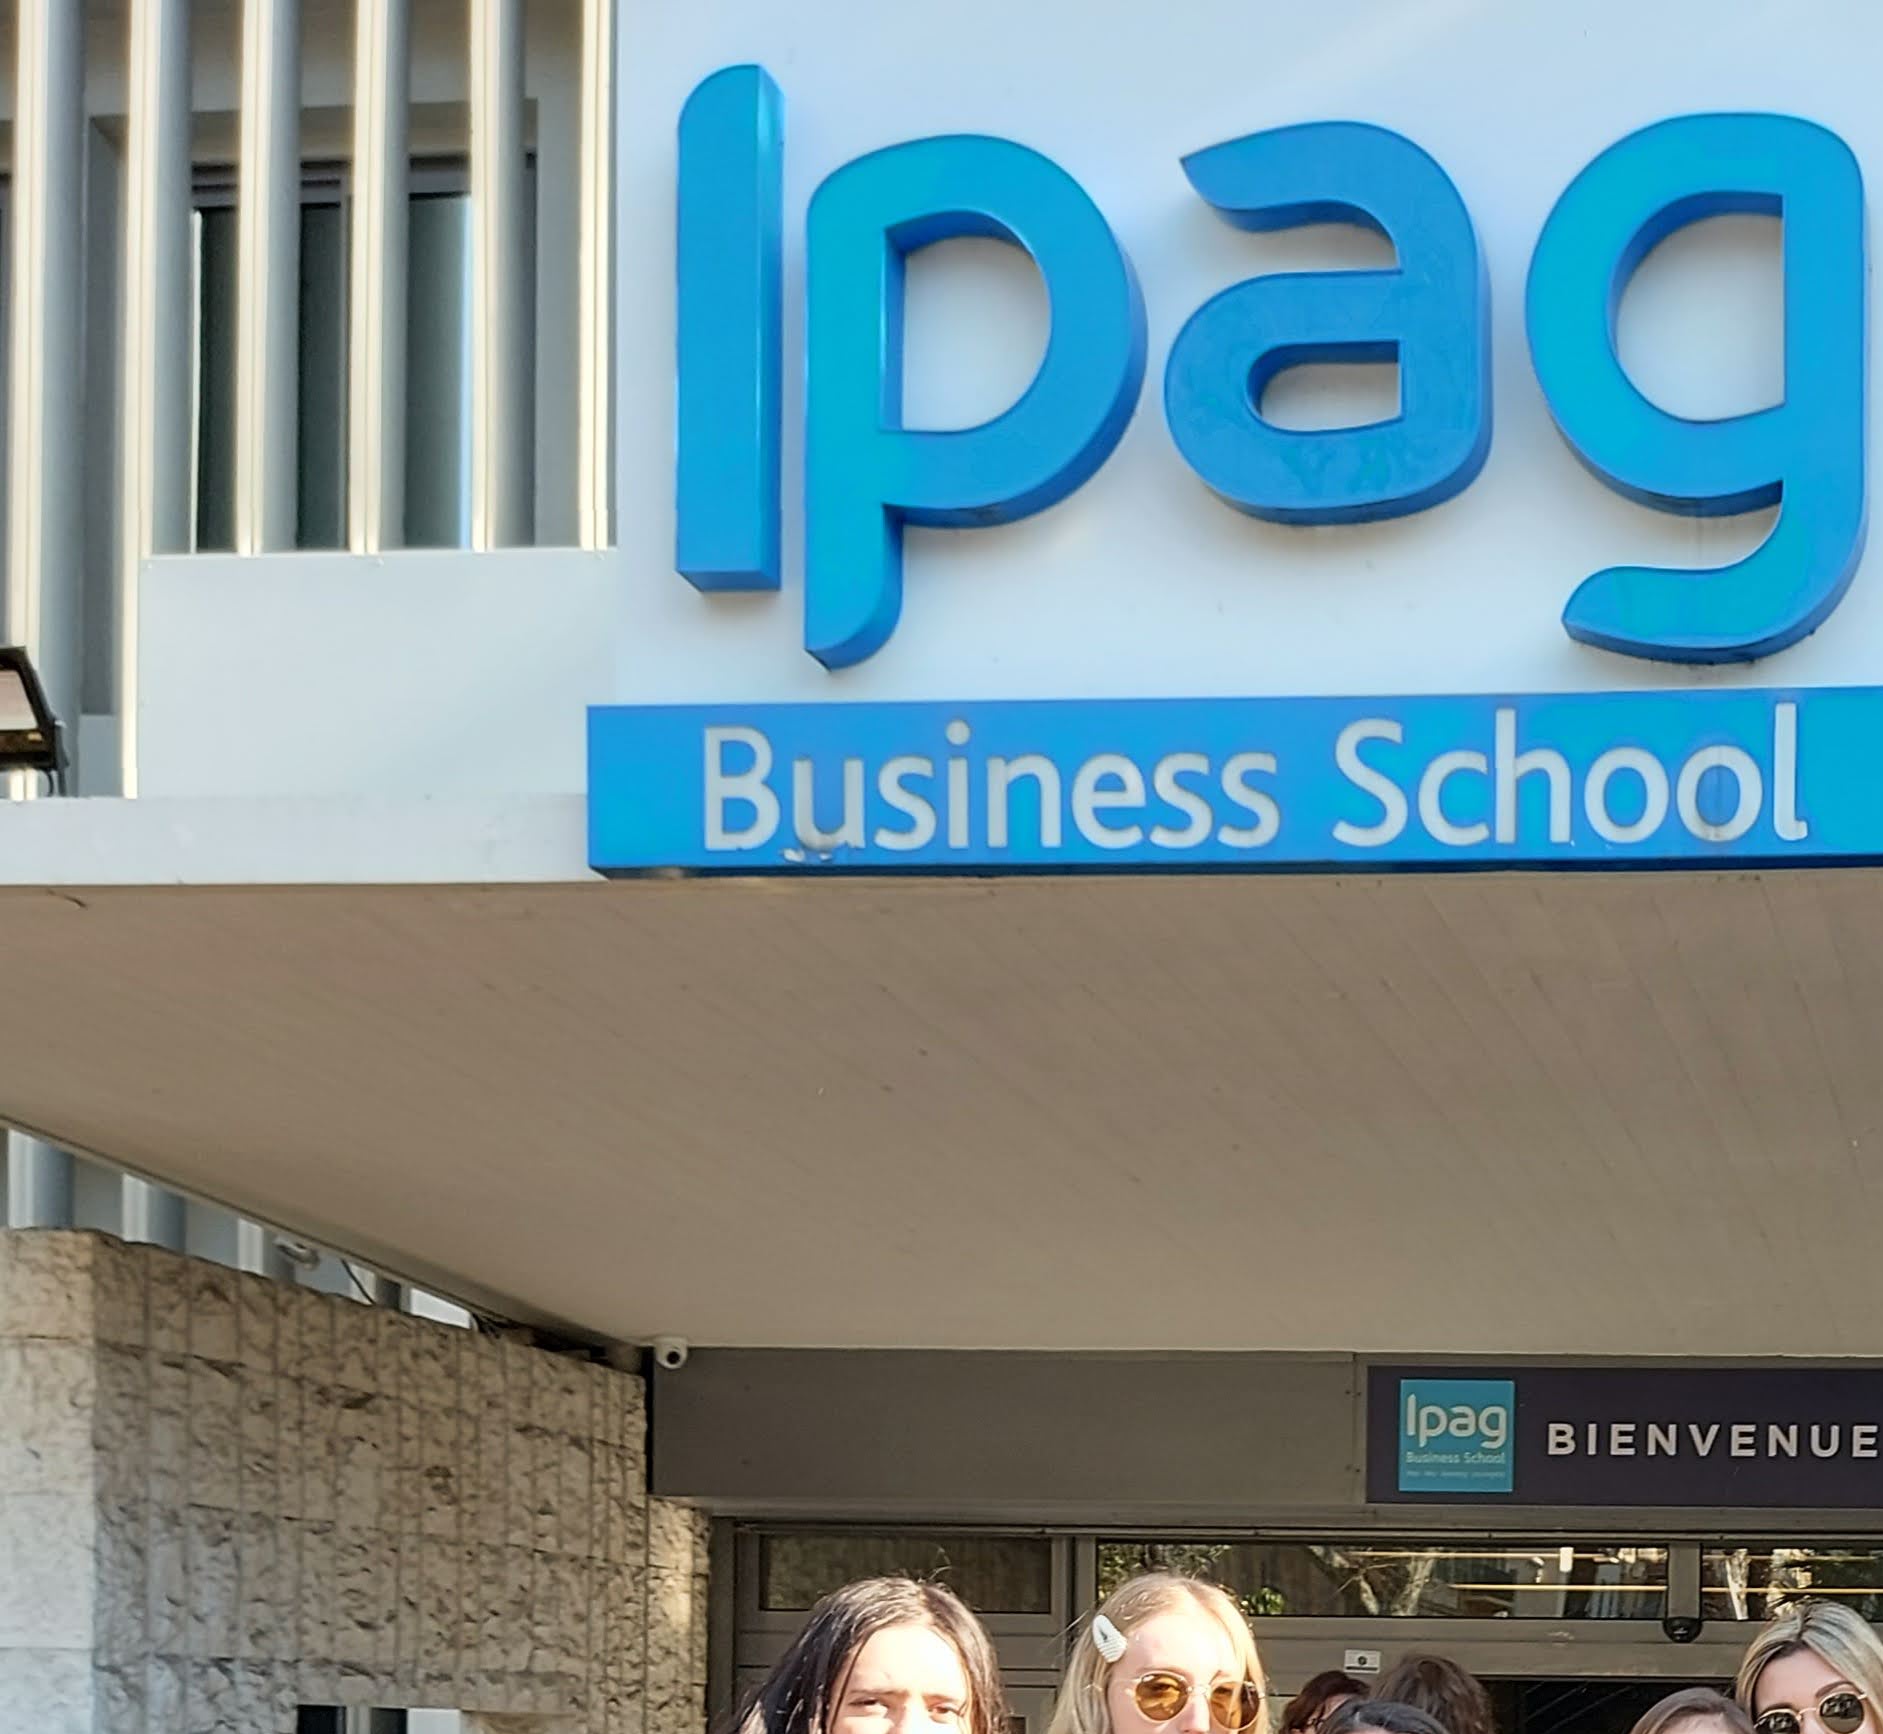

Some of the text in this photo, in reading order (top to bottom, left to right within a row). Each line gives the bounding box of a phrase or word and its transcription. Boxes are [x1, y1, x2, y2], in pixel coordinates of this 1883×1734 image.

[677, 64, 1867, 672] Ipag
[704, 701, 1808, 855] Business School
[1406, 1393, 1507, 1449] Ipag
[1548, 1423, 1878, 1457] BIENVENUE
